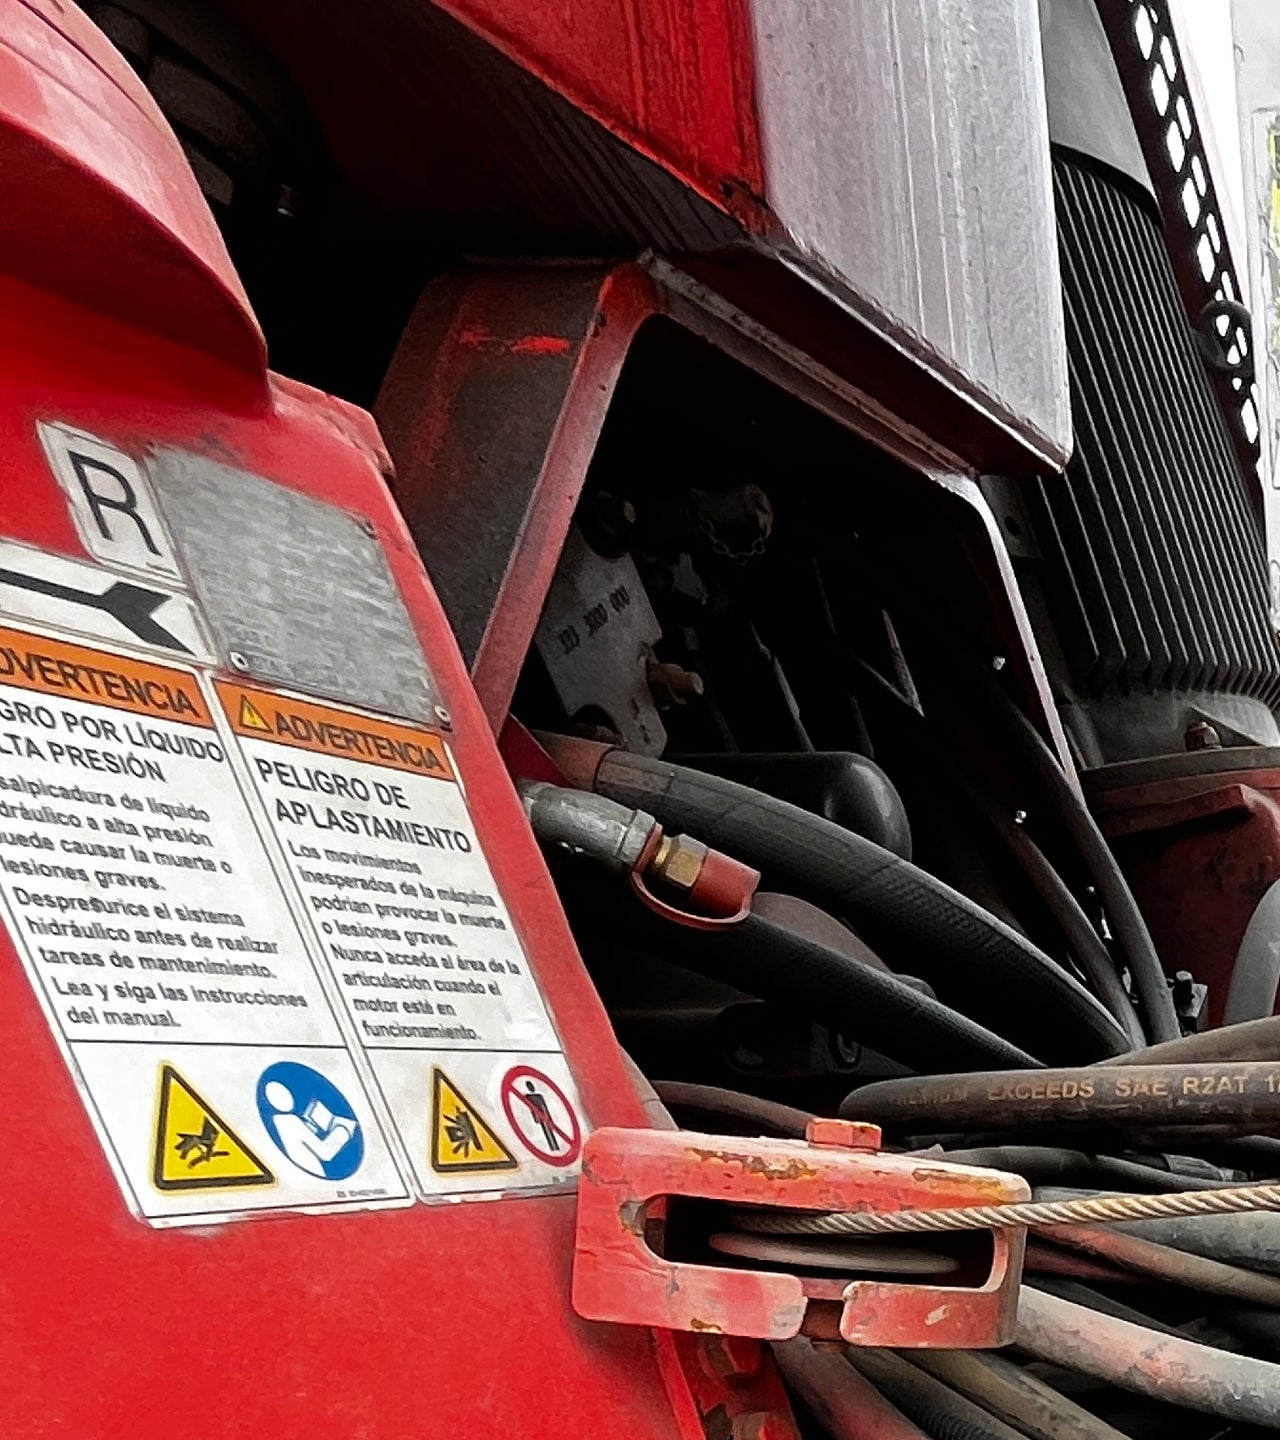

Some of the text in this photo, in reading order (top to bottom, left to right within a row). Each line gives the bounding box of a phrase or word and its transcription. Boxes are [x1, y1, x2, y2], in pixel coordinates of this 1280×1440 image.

[67, 450, 163, 557] R
[0, 648, 200, 718] DVERTENCIA
[61, 711, 123, 743] POR
[123, 722, 225, 763] LÍQUIDO
[275, 711, 446, 773] ADVERTENCIA
[46, 740, 167, 783] PRESIÓN
[254, 757, 411, 810] PELIGRO DE
[120, 793, 144, 811] de
[0, 800, 214, 847] dráulico a alta presión
[276, 798, 472, 853] APLASTAMIENTO
[0, 855, 167, 890] lesiones graves.
[60, 838, 126, 860] causar
[129, 844, 151, 864] la
[153, 851, 217, 872] muerte
[220, 860, 233, 874] o
[287, 839, 422, 875] Los movimientos
[297, 865, 397, 895] inesperados
[400, 880, 418, 898] de
[419, 883, 435, 899] la
[12, 886, 245, 927] Despresurice el sistema
[375, 902, 439, 922] provocar
[440, 908, 457, 925] la
[459, 913, 506, 931] muerte
[24, 915, 278, 954] hidráulico antes de realizar
[321, 919, 458, 948] o lesiones graves.
[38, 946, 277, 979] tareas de mantenimiento.
[330, 943, 384, 963] Nunca
[385, 951, 439, 968] acceda
[441, 954, 455, 969] al
[488, 957, 506, 974] de
[507, 959, 521, 975] la
[51, 976, 308, 1007] Lea y siga las instrucciones
[342, 971, 501, 996] articulación cuando el
[67, 1006, 181, 1027] del manual.
[353, 997, 457, 1016] motor esté en
[362, 1020, 482, 1040] funcionamiento.
[987, 1078, 1095, 1101] EXCEEDS
[1115, 1077, 1169, 1097] SAE
[1182, 1075, 1249, 1095] R2AT
